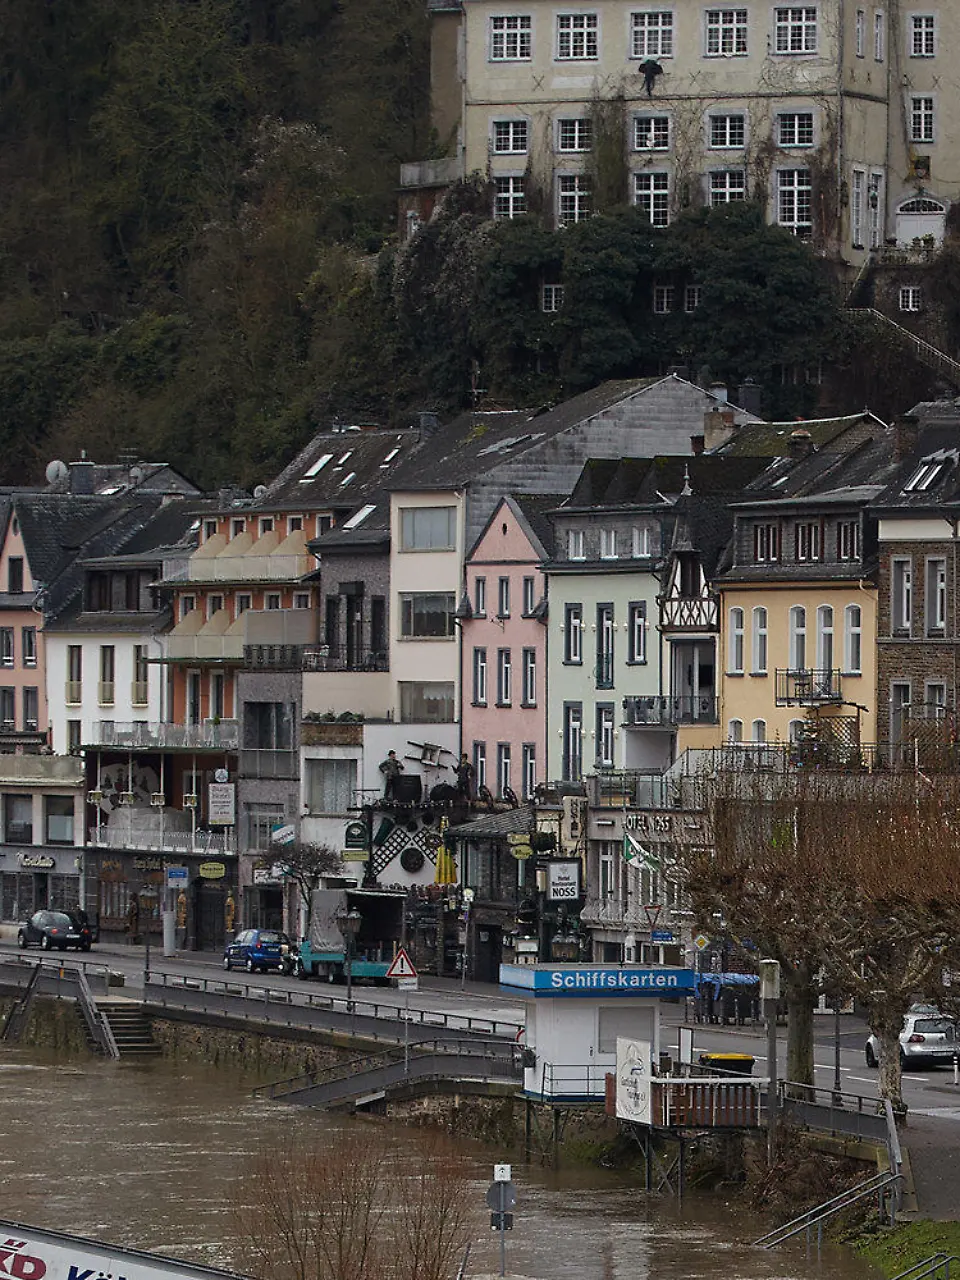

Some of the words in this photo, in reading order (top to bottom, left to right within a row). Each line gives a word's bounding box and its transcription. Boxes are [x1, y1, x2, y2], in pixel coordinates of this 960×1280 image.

[621, 814, 647, 830] OTEL
[552, 887, 576, 897] NOSS
[551, 972, 678, 988] Schiffskarten
